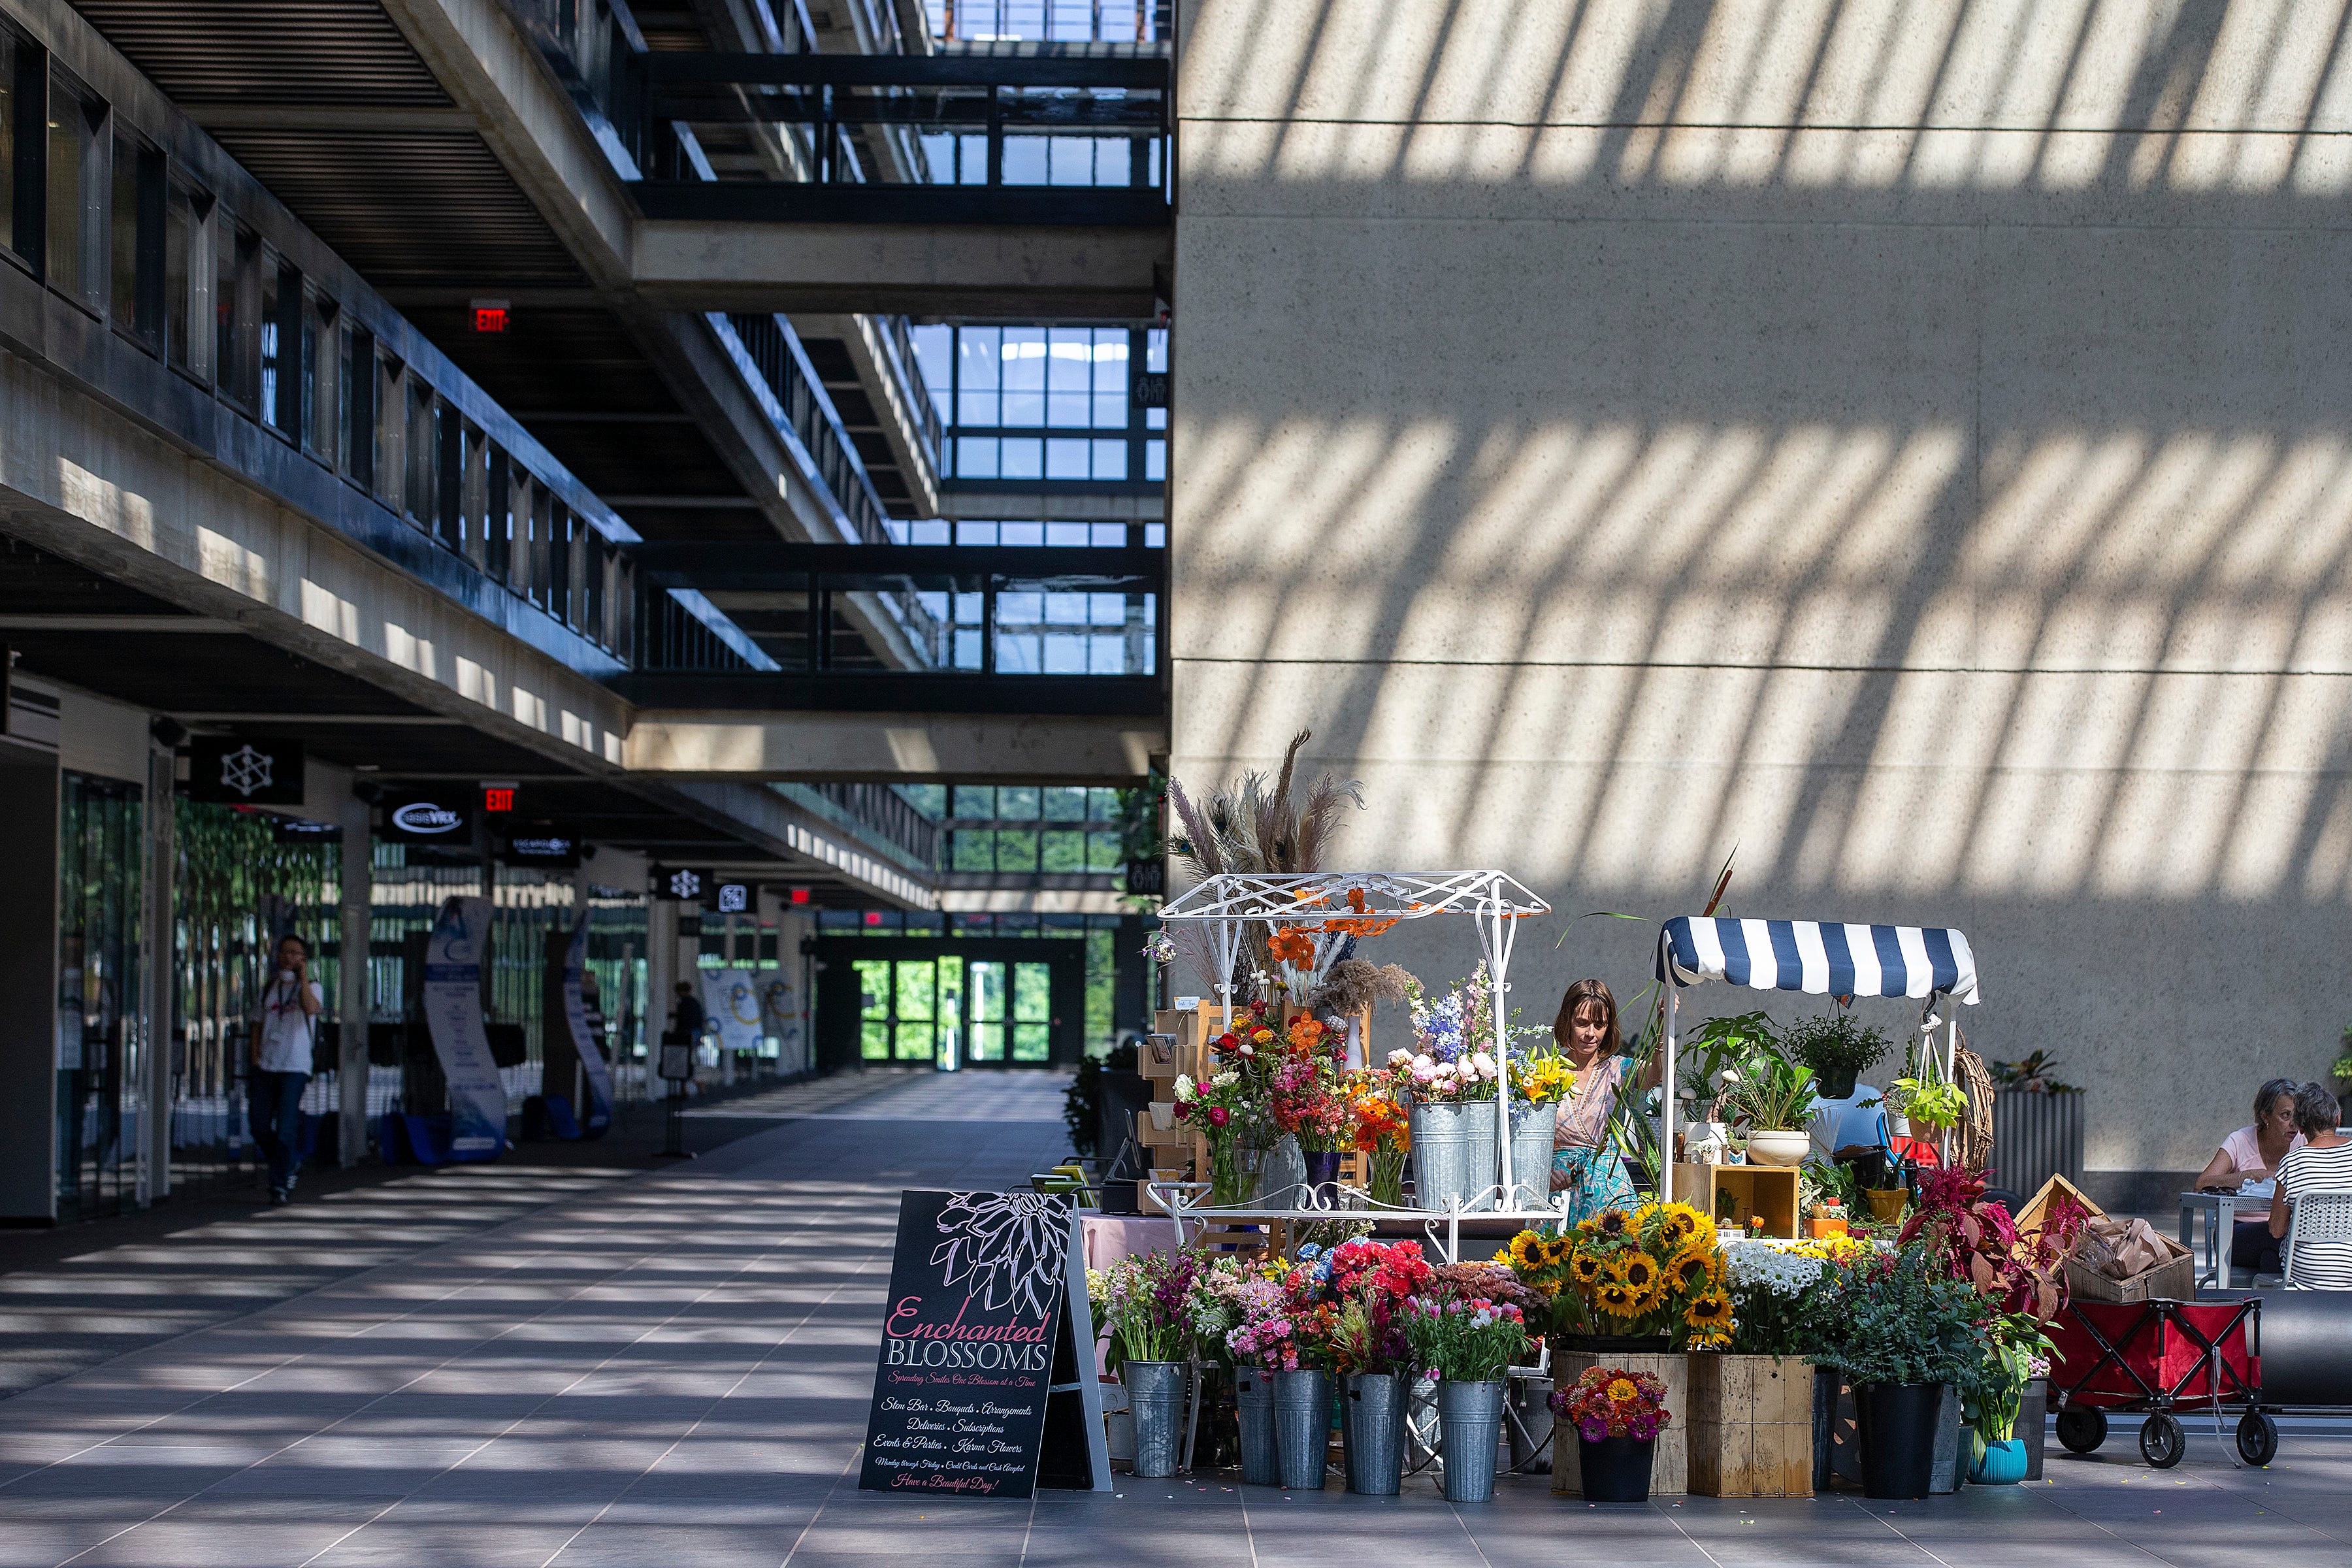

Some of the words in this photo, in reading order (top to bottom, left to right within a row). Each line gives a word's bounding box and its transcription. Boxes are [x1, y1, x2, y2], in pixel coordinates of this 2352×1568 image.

[476, 309, 506, 332] EXIT
[486, 788, 514, 811] EXIT
[886, 1296, 1051, 1343] Enchanted
[884, 1339, 1047, 1371] BLOSSOMS
[888, 1370, 924, 1386] Spreading
[925, 1372, 950, 1384] Smiles
[952, 1373, 966, 1384] One
[968, 1374, 999, 1385] Blossom
[1000, 1377, 1009, 1386] at
[1015, 1376, 1036, 1387] Time
[881, 1397, 906, 1411] Stem
[907, 1398, 928, 1411] Bar
[935, 1399, 975, 1416] Bouquets
[981, 1401, 1032, 1419] Arrangements
[906, 1416, 945, 1430] Deliveries
[952, 1418, 1005, 1436] Subscriptions
[874, 1433, 901, 1447] Events
[902, 1436, 913, 1448] &
[912, 1436, 942, 1449] Parties
[952, 1438, 986, 1453] Karma
[987, 1440, 1023, 1454] Flowers
[875, 1456, 900, 1469] Monday
[900, 1460, 919, 1469] through
[919, 1459, 940, 1471] Friday
[945, 1460, 962, 1469] Credit
[962, 1461, 978, 1471] Cards
[988, 1462, 1002, 1472] Cash
[1002, 1463, 1025, 1474] Accepted
[891, 1473, 921, 1487] Have
[929, 1475, 971, 1493] Beautiful
[970, 1477, 1000, 1494] Day!
